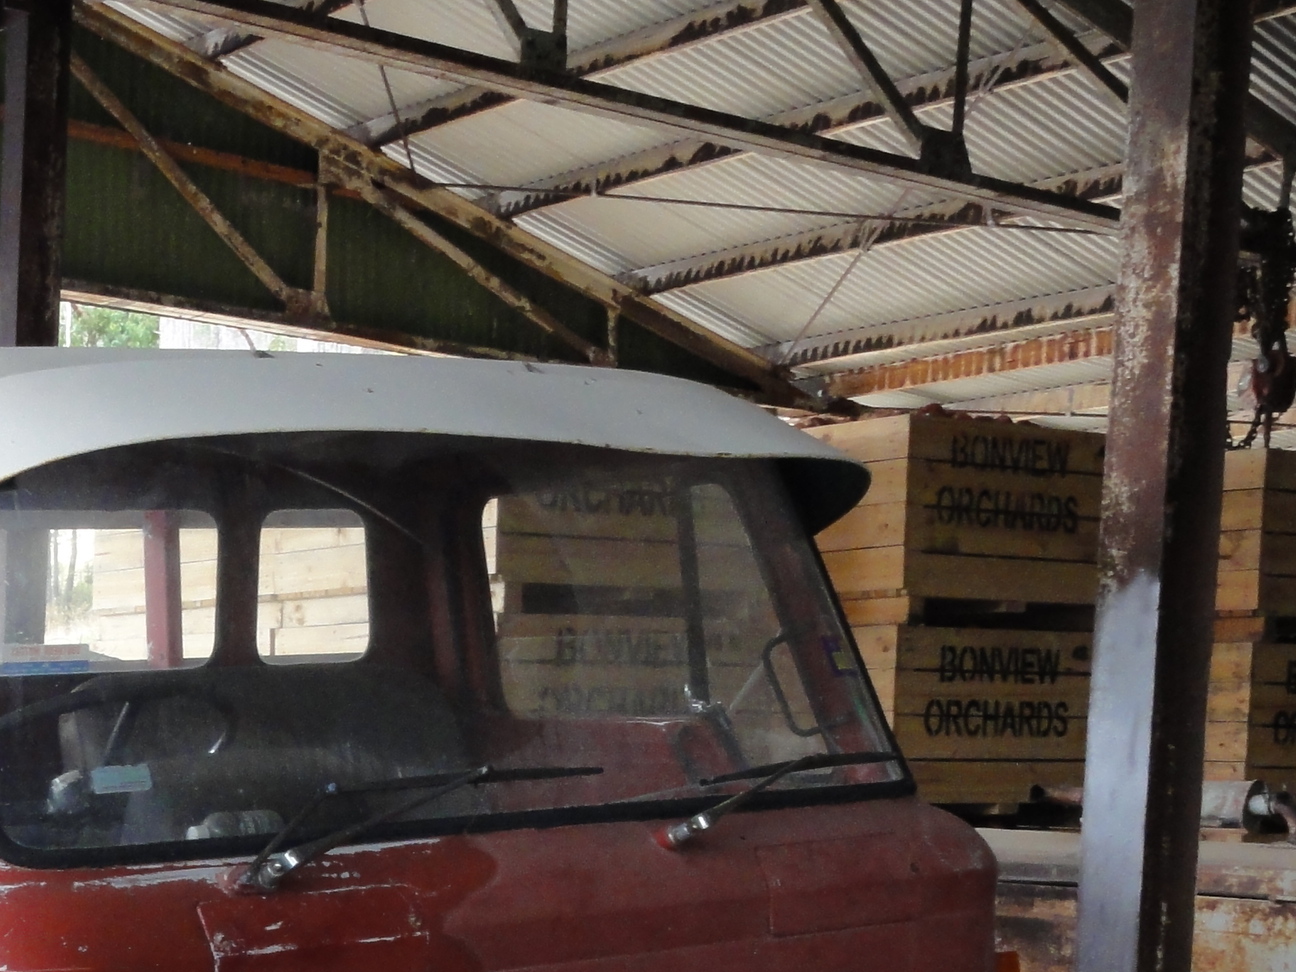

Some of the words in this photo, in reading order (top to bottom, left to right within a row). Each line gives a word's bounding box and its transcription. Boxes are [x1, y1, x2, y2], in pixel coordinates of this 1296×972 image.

[951, 434, 1071, 478] BONVIEW
[936, 485, 1079, 534] ORCHARDS
[939, 644, 1060, 685] BONVIEW
[923, 700, 1069, 738] ORCHARDS
